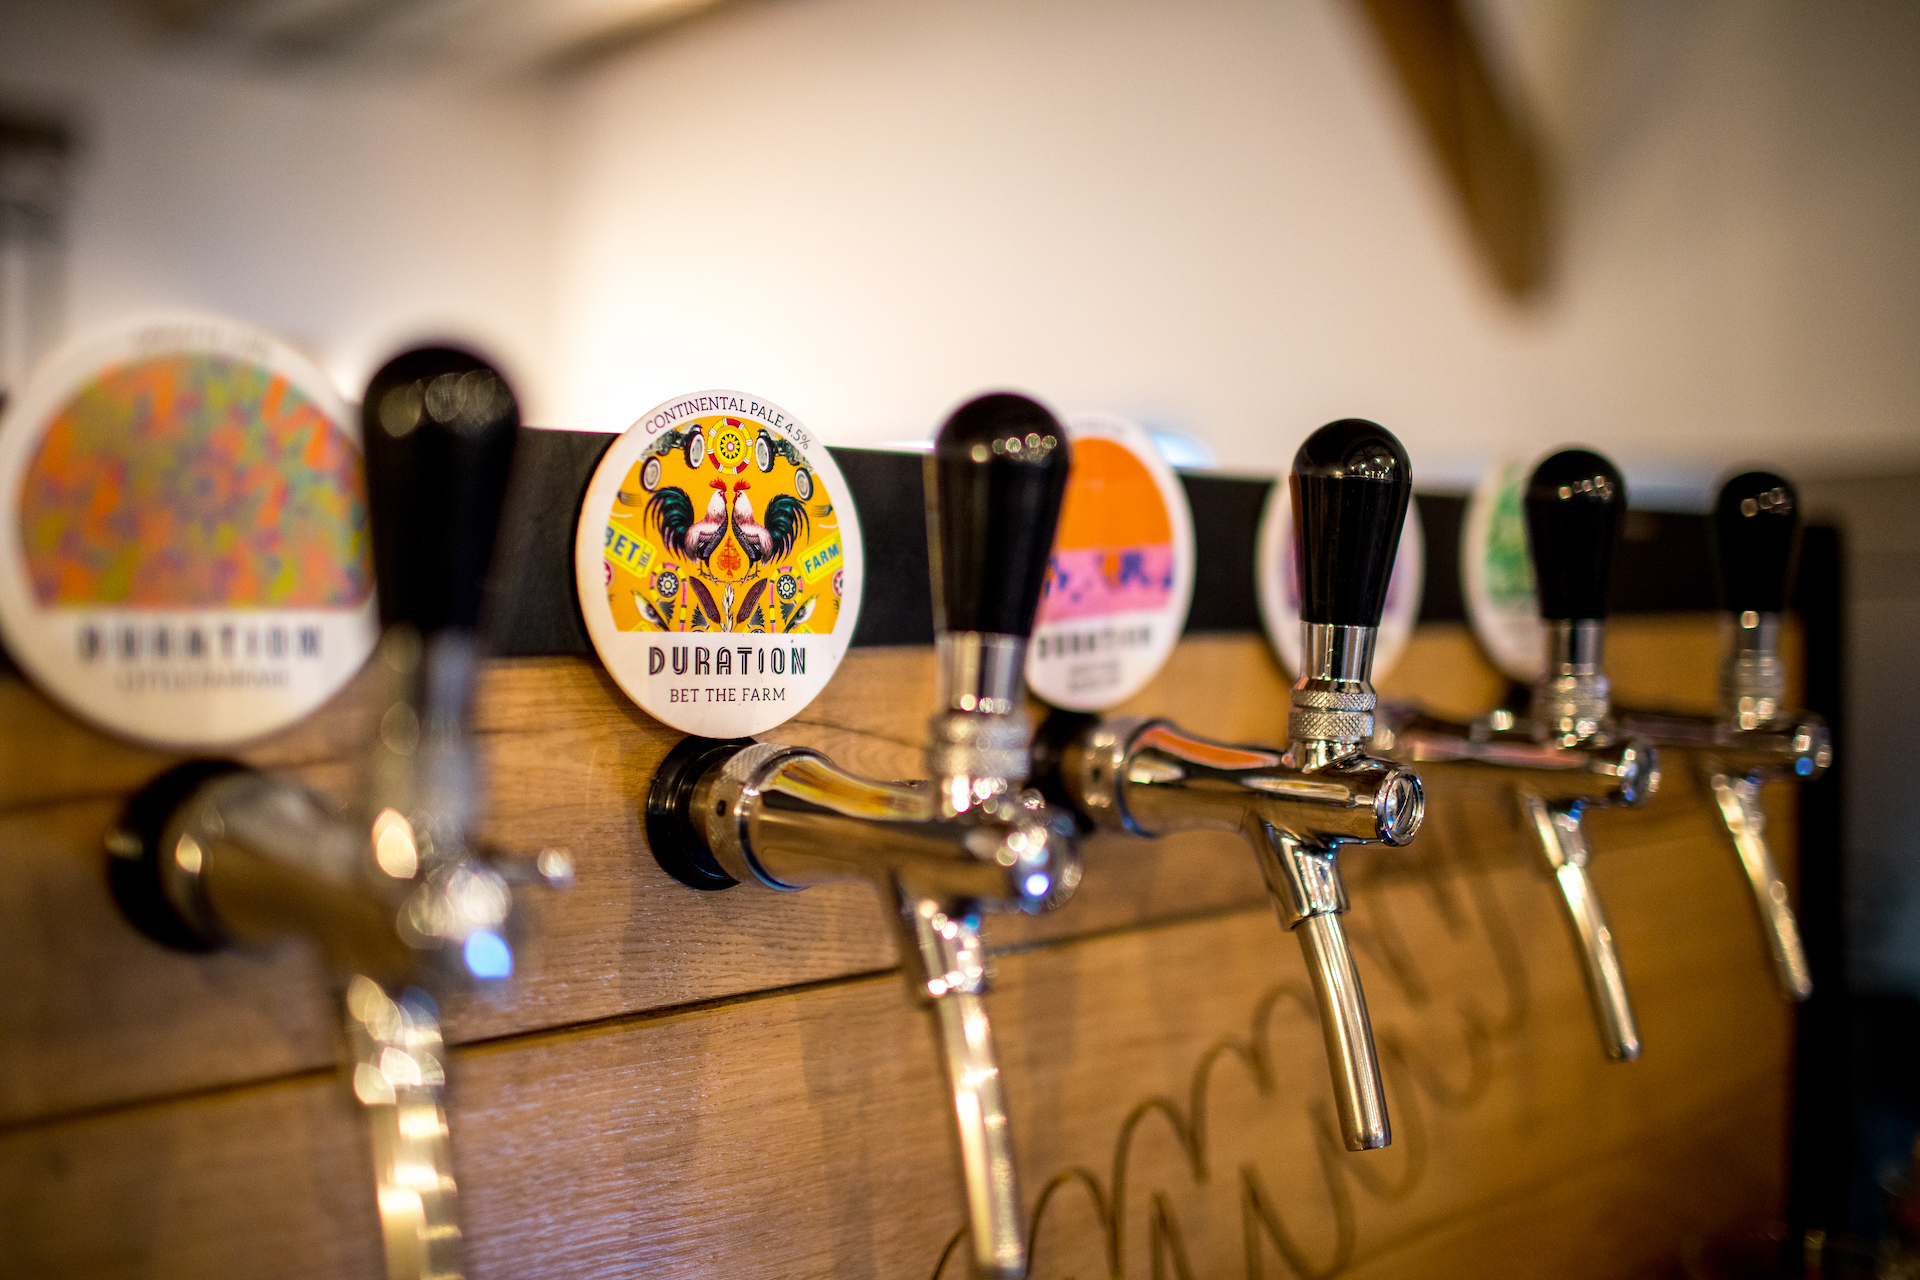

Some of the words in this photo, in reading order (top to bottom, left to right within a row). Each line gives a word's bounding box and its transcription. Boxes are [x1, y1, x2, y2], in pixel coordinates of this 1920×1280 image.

[645, 396, 747, 435] CONTINENTAL
[750, 402, 785, 428] PALE
[785, 422, 812, 451] 4.5%
[604, 525, 640, 562] BET
[804, 543, 840, 574] FARM
[648, 646, 807, 676] DURATION
[669, 688, 700, 703] BET
[705, 688, 736, 703] THE
[741, 687, 786, 702] FARM
